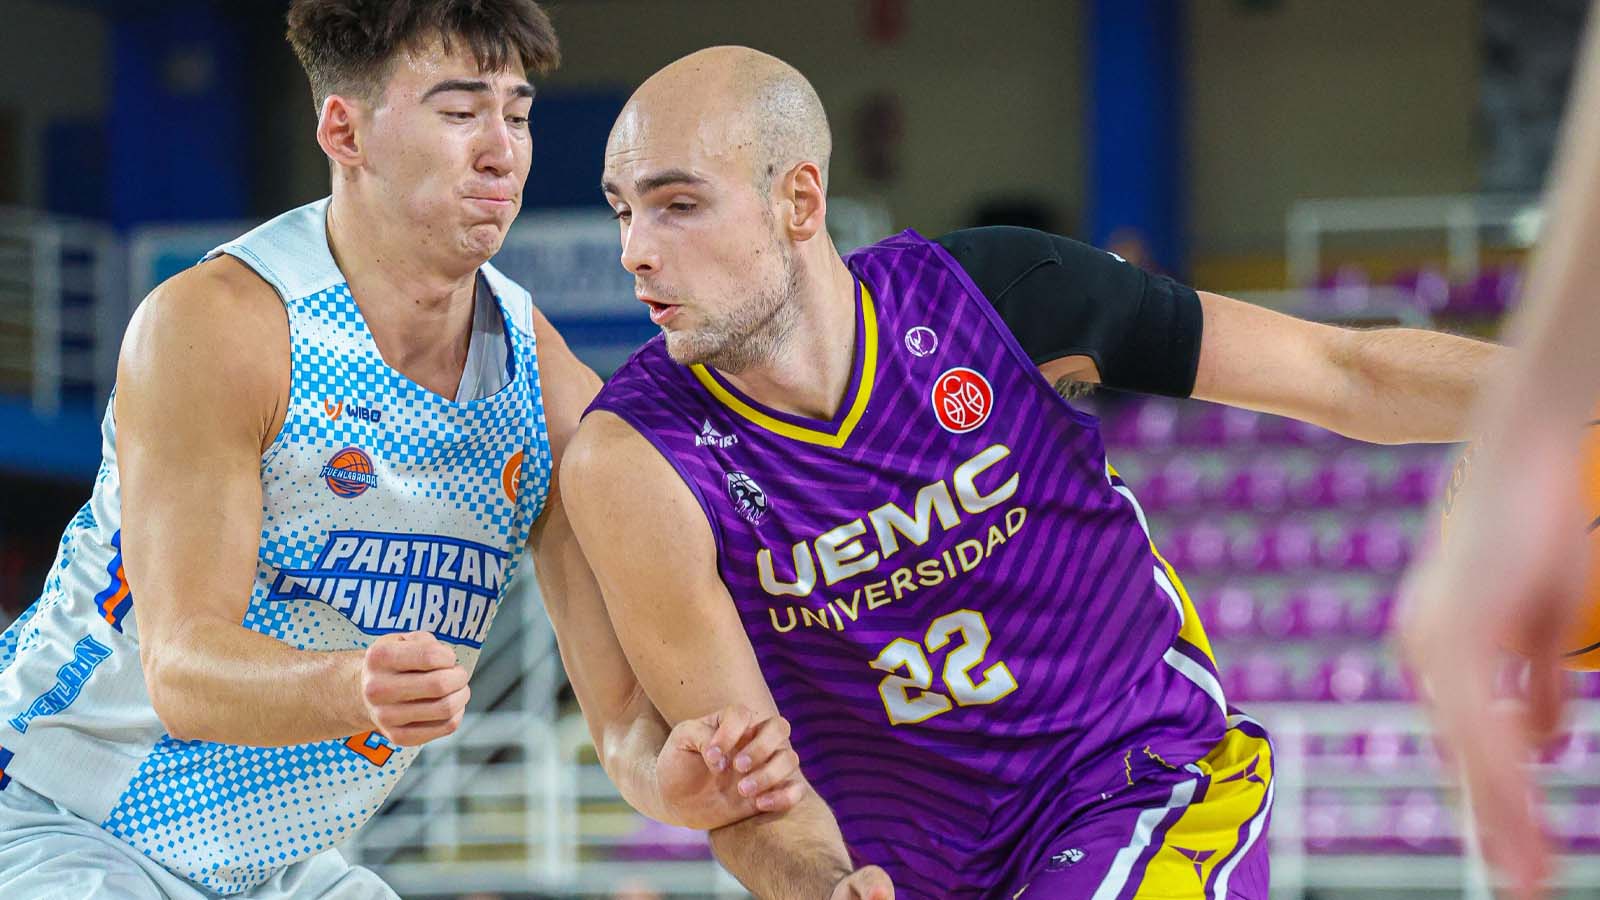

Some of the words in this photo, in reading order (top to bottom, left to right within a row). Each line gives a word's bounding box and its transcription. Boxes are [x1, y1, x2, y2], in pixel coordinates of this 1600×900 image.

[346, 404, 382, 423] WIBO
[321, 467, 377, 488] FUENLABRADA
[756, 443, 1020, 597] UEMC
[321, 537, 506, 590] PARTIZAN
[768, 507, 1028, 633] UNIVERSIDAD
[868, 608, 1019, 727] 22
